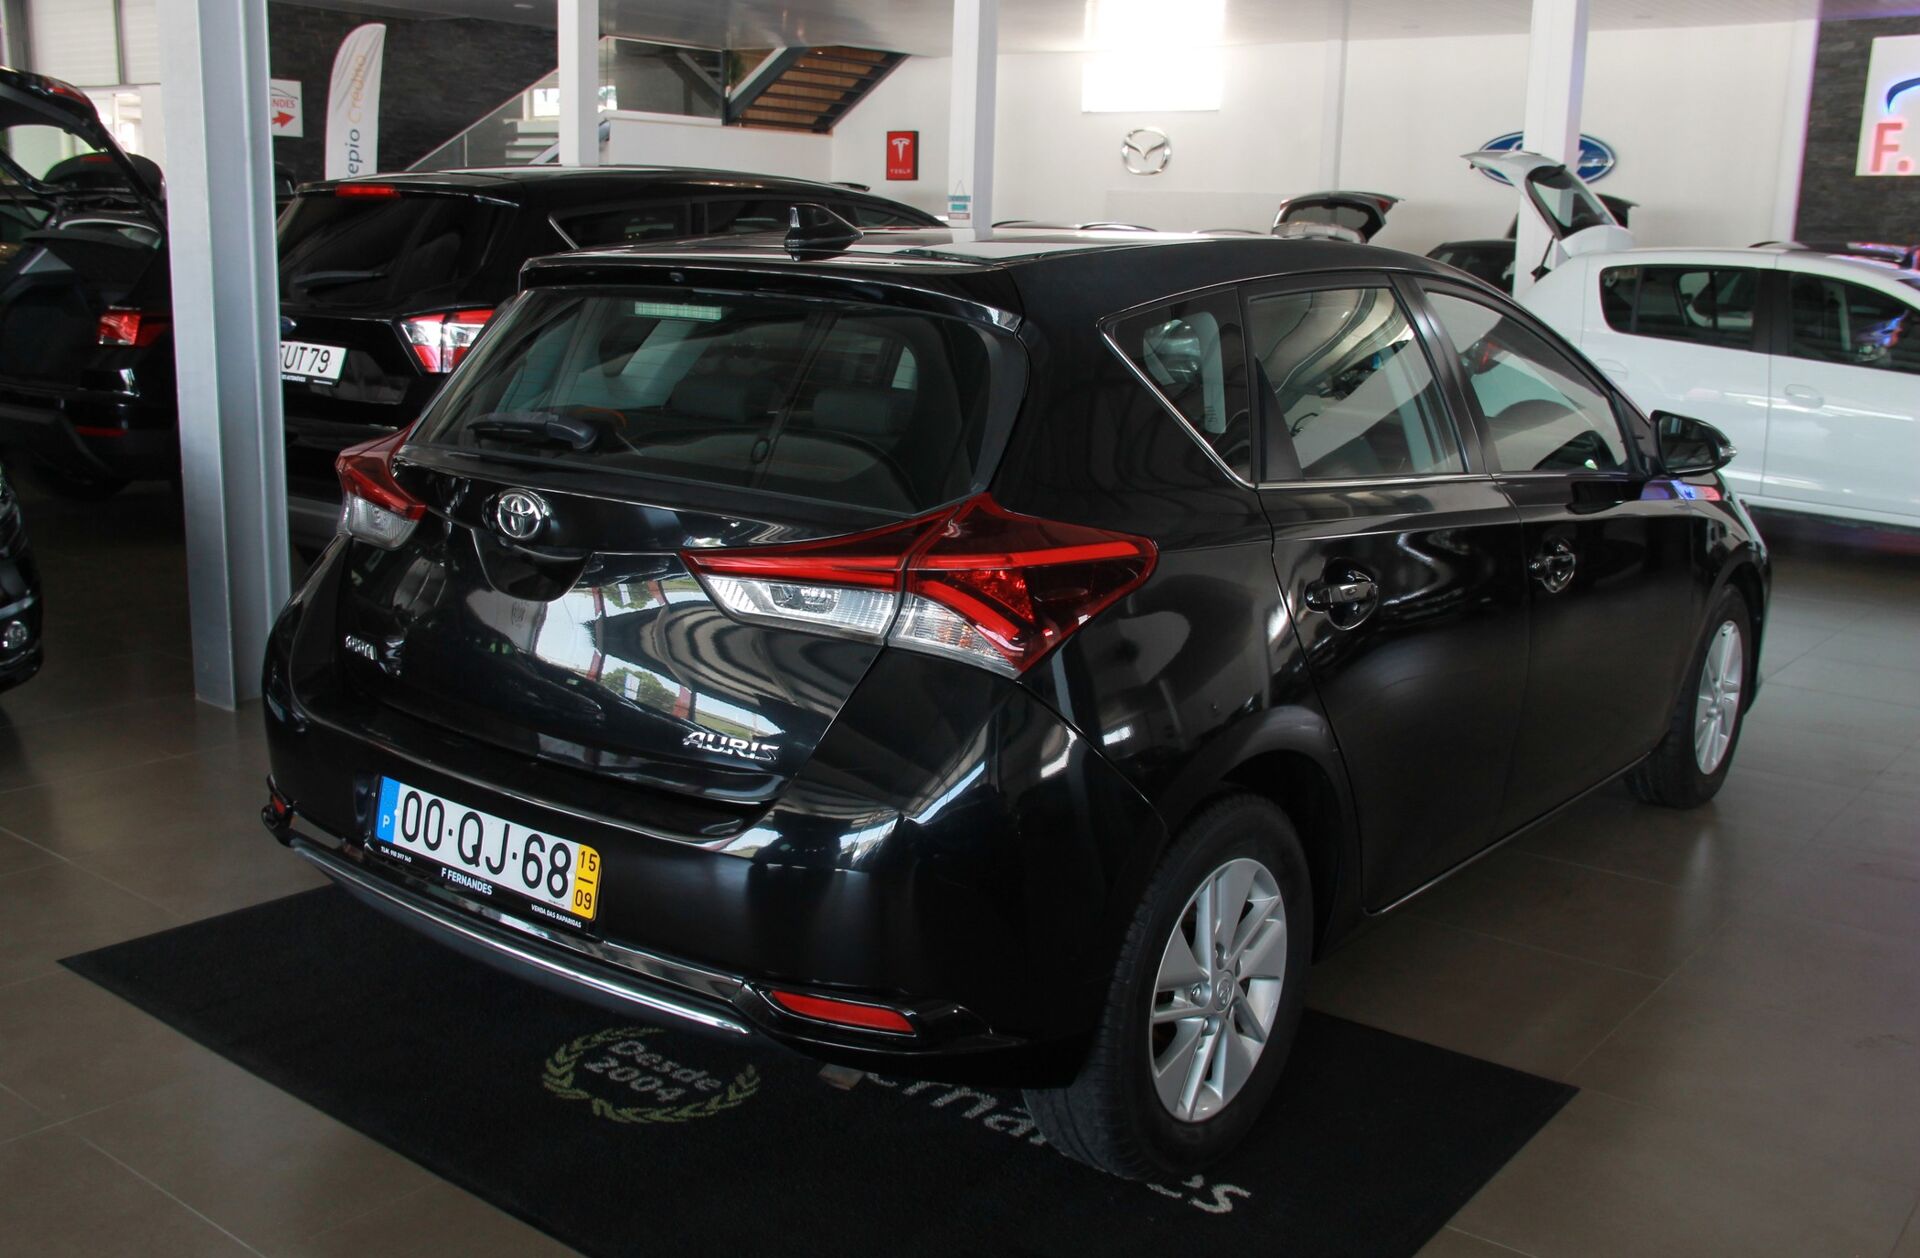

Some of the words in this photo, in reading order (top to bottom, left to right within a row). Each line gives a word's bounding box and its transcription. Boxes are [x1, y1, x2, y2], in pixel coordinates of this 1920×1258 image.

[682, 731, 780, 761] AURIS
[382, 815, 391, 829] P
[580, 850, 598, 873] 15
[441, 867, 447, 878] F
[447, 869, 493, 896] FERNANDES
[575, 889, 592, 911] 09
[608, 1040, 722, 1091] Desde
